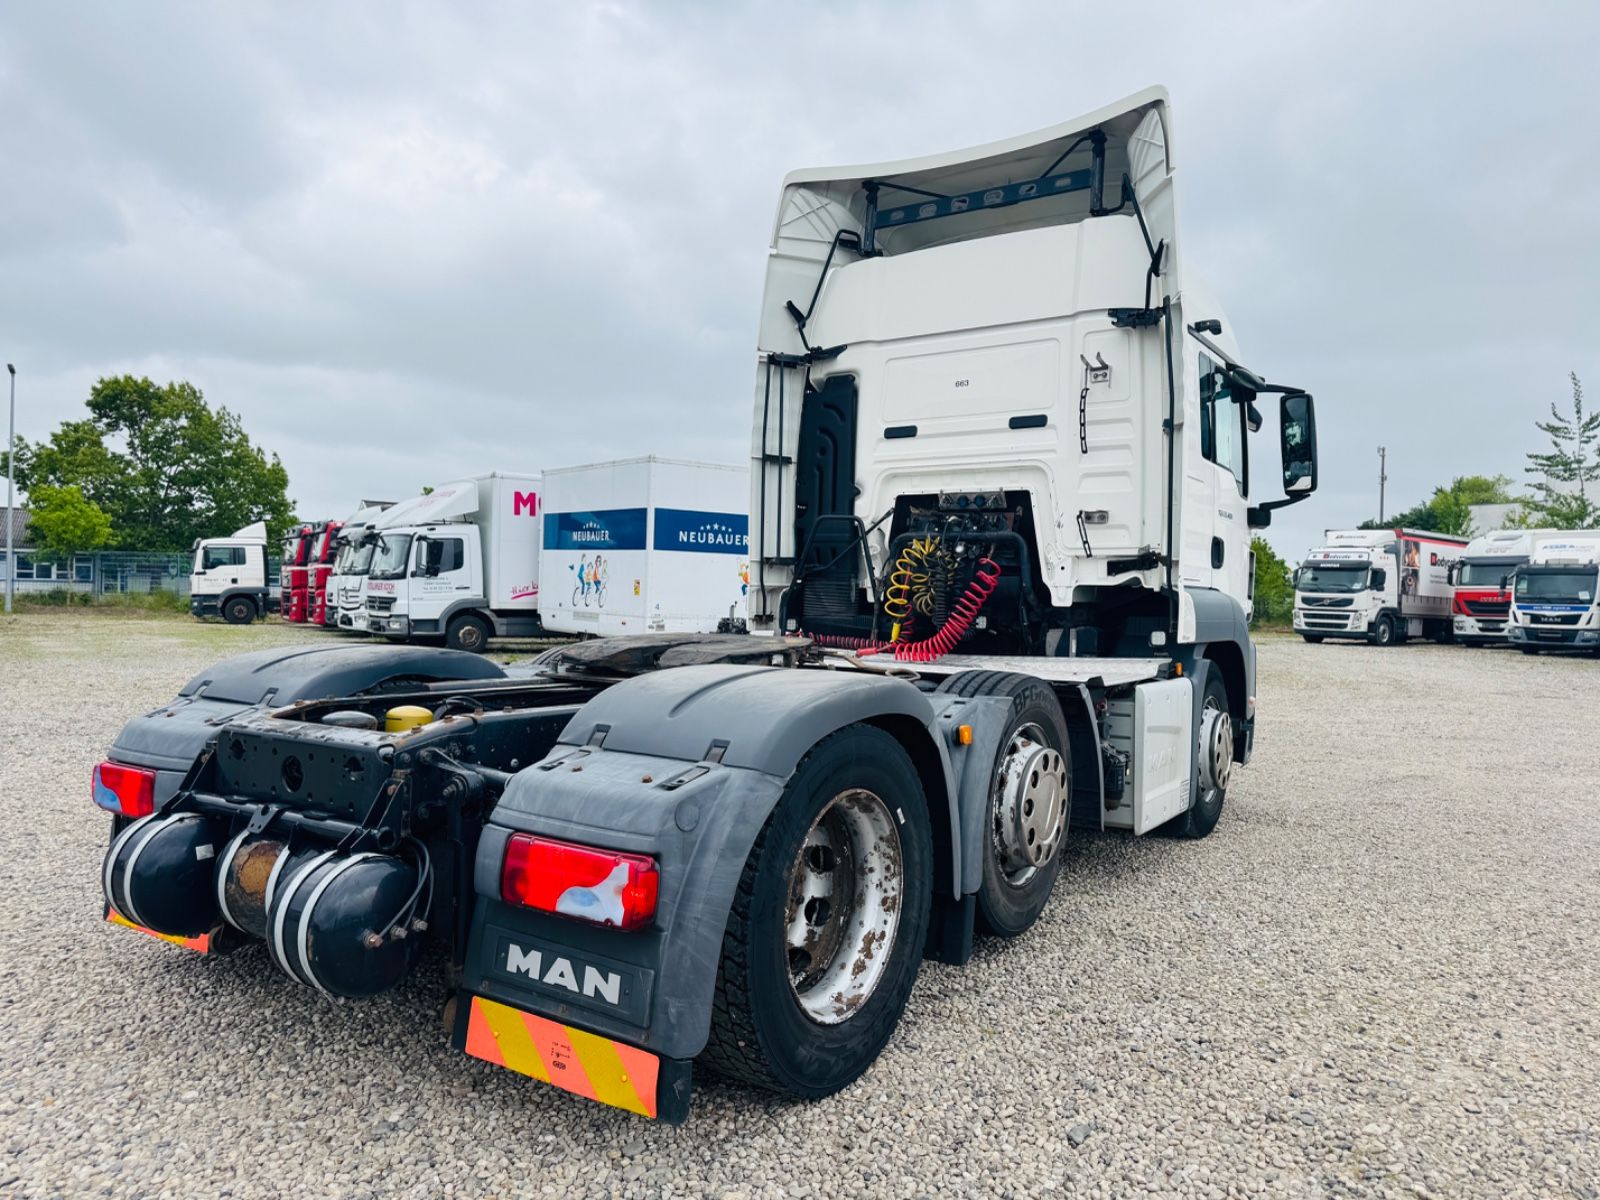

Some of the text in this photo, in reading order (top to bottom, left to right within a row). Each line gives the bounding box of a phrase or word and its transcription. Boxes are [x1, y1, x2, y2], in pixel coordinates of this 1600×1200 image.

[955, 380, 969, 388] 663
[513, 491, 541, 517] M
[572, 529, 610, 542] NEUBAUER
[679, 530, 750, 546] NEUBAUER
[505, 943, 622, 1006] MAN
